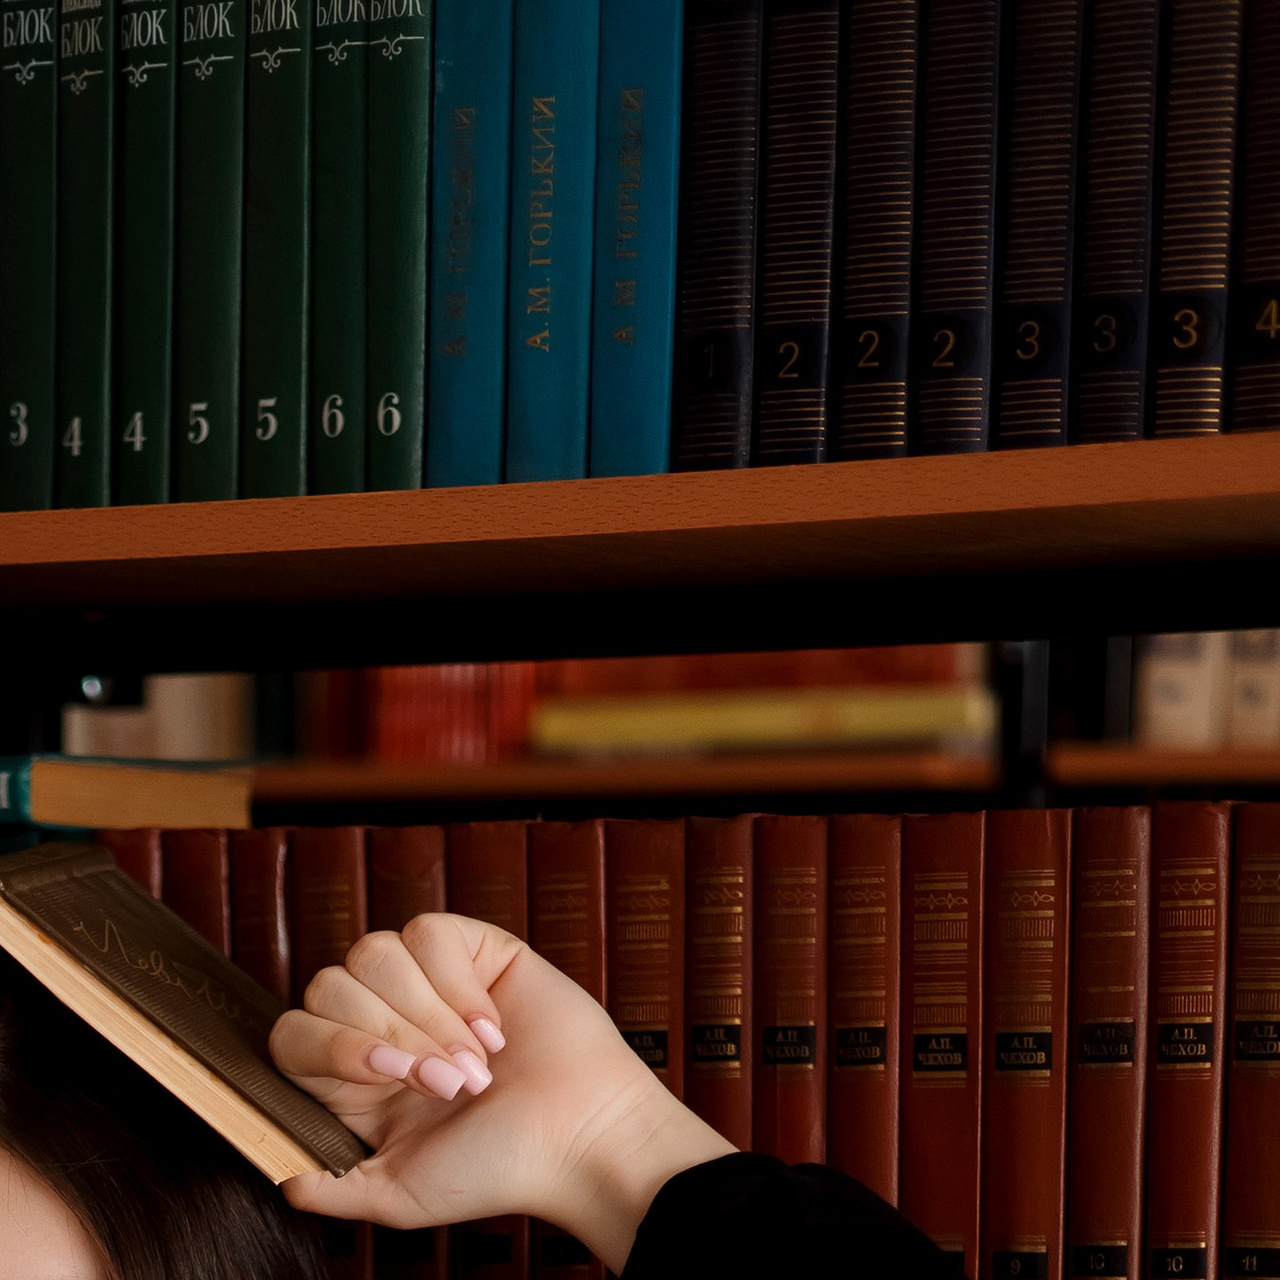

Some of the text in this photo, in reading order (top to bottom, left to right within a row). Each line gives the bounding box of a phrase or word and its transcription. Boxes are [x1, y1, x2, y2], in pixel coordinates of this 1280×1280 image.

[3, 8, 54, 48] БЛОК
[61, 16, 104, 58] БЛОК
[121, 9, 168, 51] БЛОК
[183, 2, 234, 42] БЛОК
[250, 0, 301, 35] БЛОК
[527, 95, 556, 267] ГОРЬКИЙ
[1094, 314, 1118, 353] 3
[1173, 308, 1200, 350] 3
[1255, 298, 1280, 339] 4
[778, 341, 801, 379] 2
[857, 330, 881, 368] 2
[932, 329, 957, 368] 2
[1016, 320, 1042, 360] 3
[9, 402, 29, 446] 3
[122, 411, 146, 452] 4
[187, 402, 211, 444] 5
[255, 397, 279, 440] 5
[321, 394, 345, 438] 6
[376, 392, 401, 436] 6
[62, 416, 84, 457] 4
[918, 1052, 962, 1066] ЧЕХОВ
[1000, 1051, 1046, 1065] ЧЕХОВ
[1161, 1043, 1206, 1056] ЧЕХОВ
[1239, 1041, 1280, 1054] ЧЕХО
[1010, 1259, 1021, 1275] 9
[1089, 1253, 1105, 1271] 10
[1166, 1256, 1183, 1273] 10
[1242, 1255, 1259, 1271] 11
